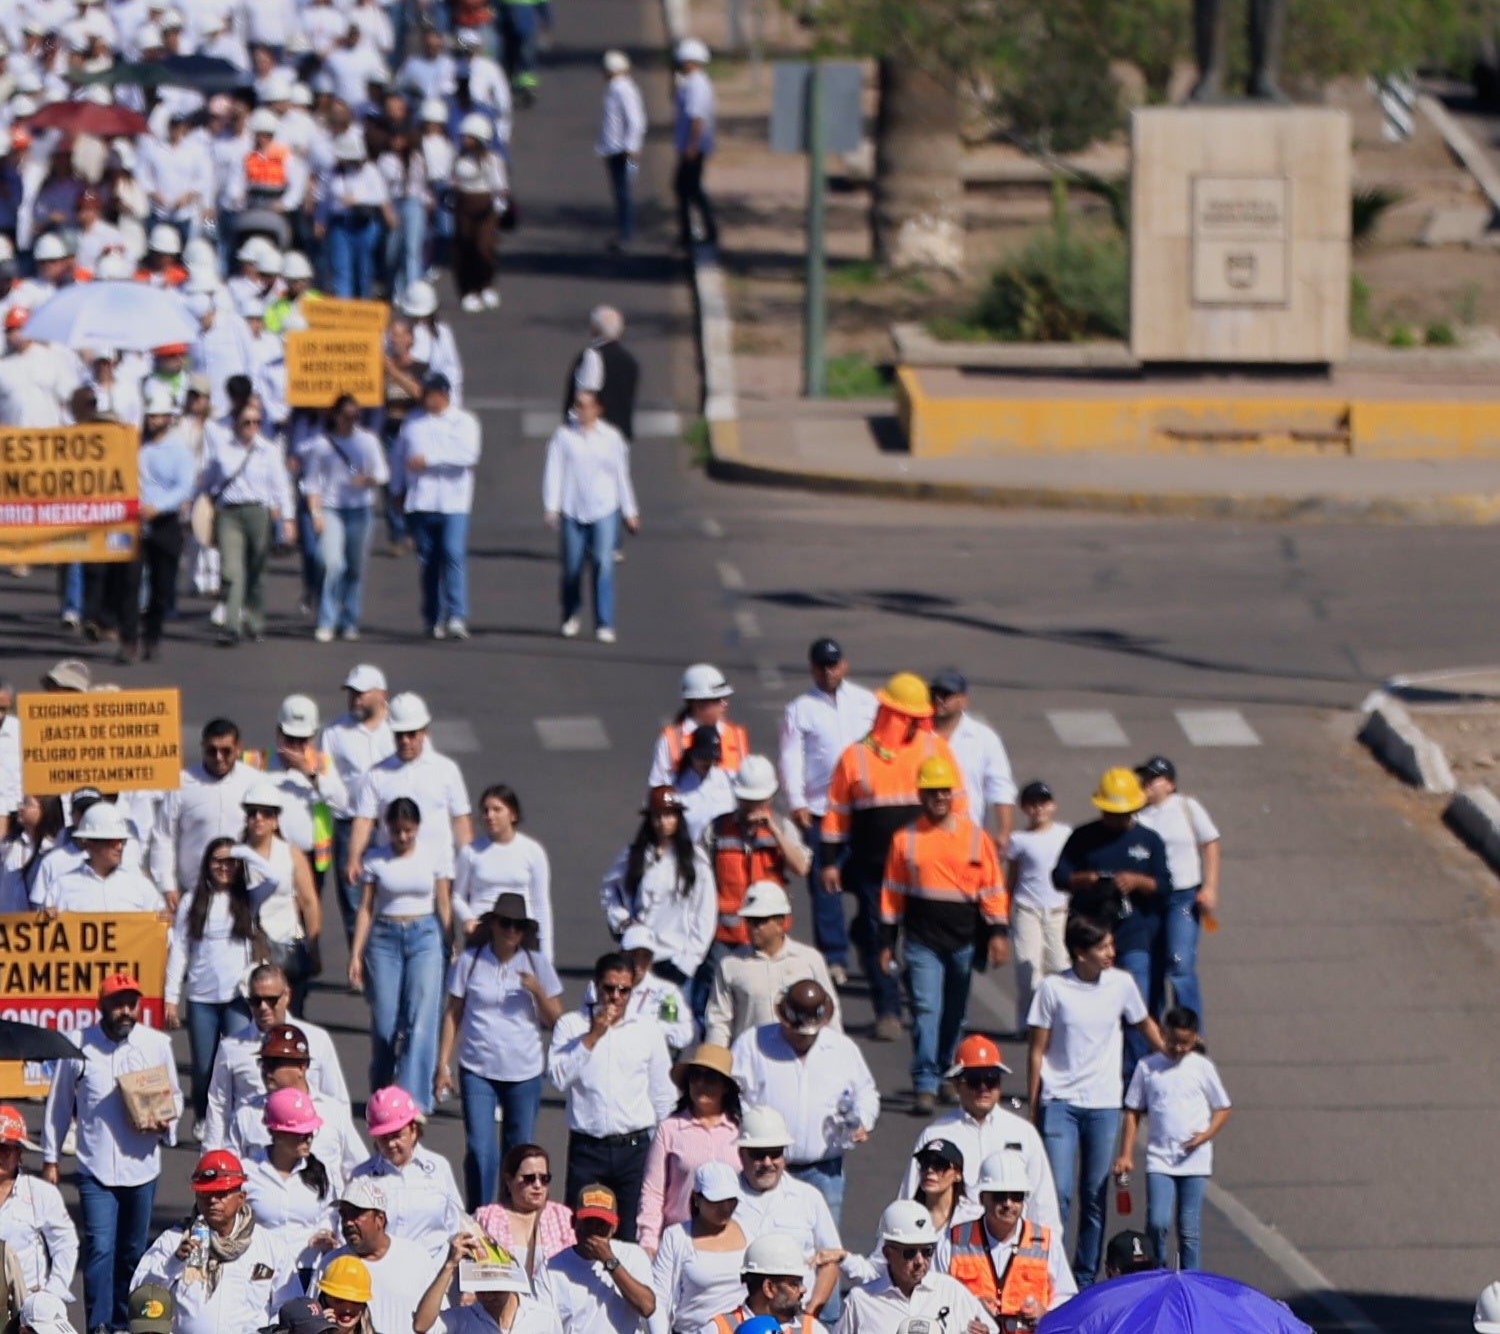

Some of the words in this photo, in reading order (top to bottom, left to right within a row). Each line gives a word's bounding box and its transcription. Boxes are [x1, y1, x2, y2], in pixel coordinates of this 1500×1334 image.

[29, 703, 90, 719] EXIGIMOS
[93, 702, 169, 717] SEGURIDAD.
[41, 725, 87, 742] ¡BASTA
[90, 725, 105, 739] DE
[109, 723, 159, 738] CORRER
[26, 747, 77, 762] PELIGRO
[80, 746, 105, 760] POR
[110, 742, 179, 759] TRABAJAR
[49, 766, 153, 783] HONESTAMENTE!
[81, 922, 117, 952] DE
